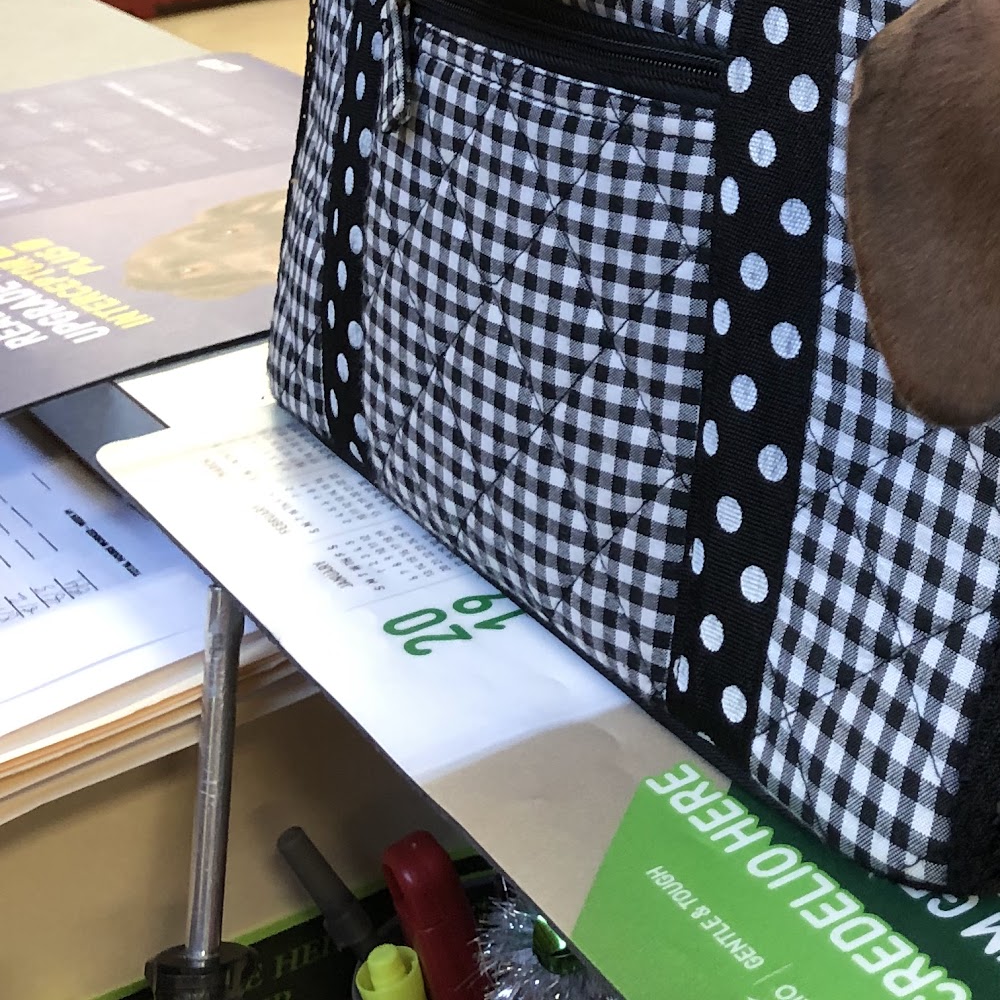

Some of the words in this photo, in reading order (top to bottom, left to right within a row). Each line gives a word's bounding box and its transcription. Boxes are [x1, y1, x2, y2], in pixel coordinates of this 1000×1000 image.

[383, 608, 472, 656] 20
[452, 593, 526, 629] 19
[646, 763, 769, 853] HERE
[646, 865, 698, 909] TOUGH
[694, 906, 709, 921] &
[700, 915, 765, 969] GENTLE
